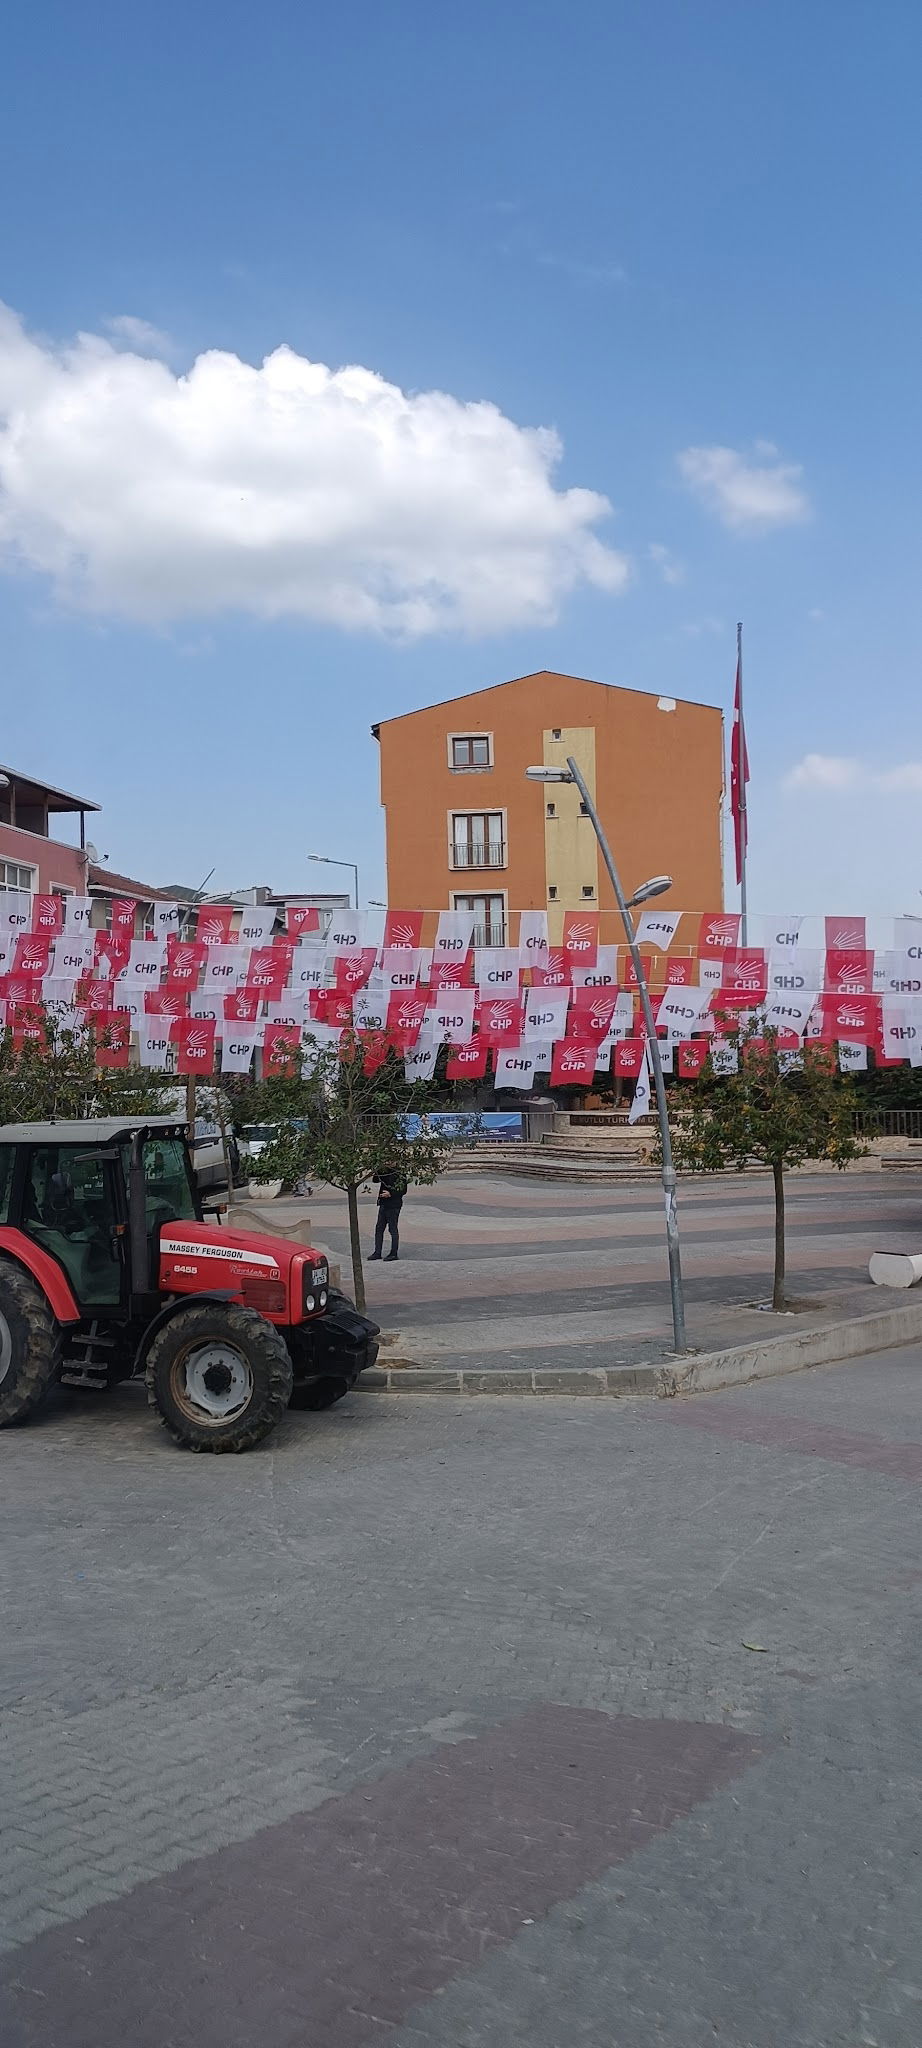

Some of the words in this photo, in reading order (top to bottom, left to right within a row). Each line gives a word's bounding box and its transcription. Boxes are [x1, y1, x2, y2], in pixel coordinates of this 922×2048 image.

[9, 915, 26, 925] CHP
[647, 923, 673, 933] CHP
[526, 937, 547, 949] CHP
[566, 940, 591, 950] CHP
[706, 935, 732, 946] CHP
[22, 960, 42, 969] CHP
[64, 956, 82, 967] CHP
[135, 964, 156, 973] CHP
[173, 968, 191, 977] CHP
[212, 966, 233, 976] CHP
[252, 976, 273, 985] CHP
[346, 970, 363, 981] CHP
[391, 975, 415, 984] CHP
[488, 971, 512, 982] CHP
[543, 973, 564, 985] CHP
[439, 981, 460, 990] CHP
[584, 976, 611, 986] CHP
[734, 980, 760, 989] CHP
[838, 984, 864, 993] CHP
[398, 1018, 421, 1027] CHP
[490, 1019, 512, 1029] CHP
[837, 1016, 864, 1027] CHP
[24, 1029, 40, 1038] CHP
[147, 1040, 166, 1050] CHP
[229, 1044, 249, 1055] CHP
[187, 1048, 206, 1057] CHP
[458, 1051, 479, 1062] CHP
[506, 1059, 532, 1071] CHP
[561, 1062, 585, 1071] CHP
[169, 1244, 200, 1254] MASSEY
[202, 1247, 243, 1259] FERGUSON
[173, 1265, 197, 1274] 6455
